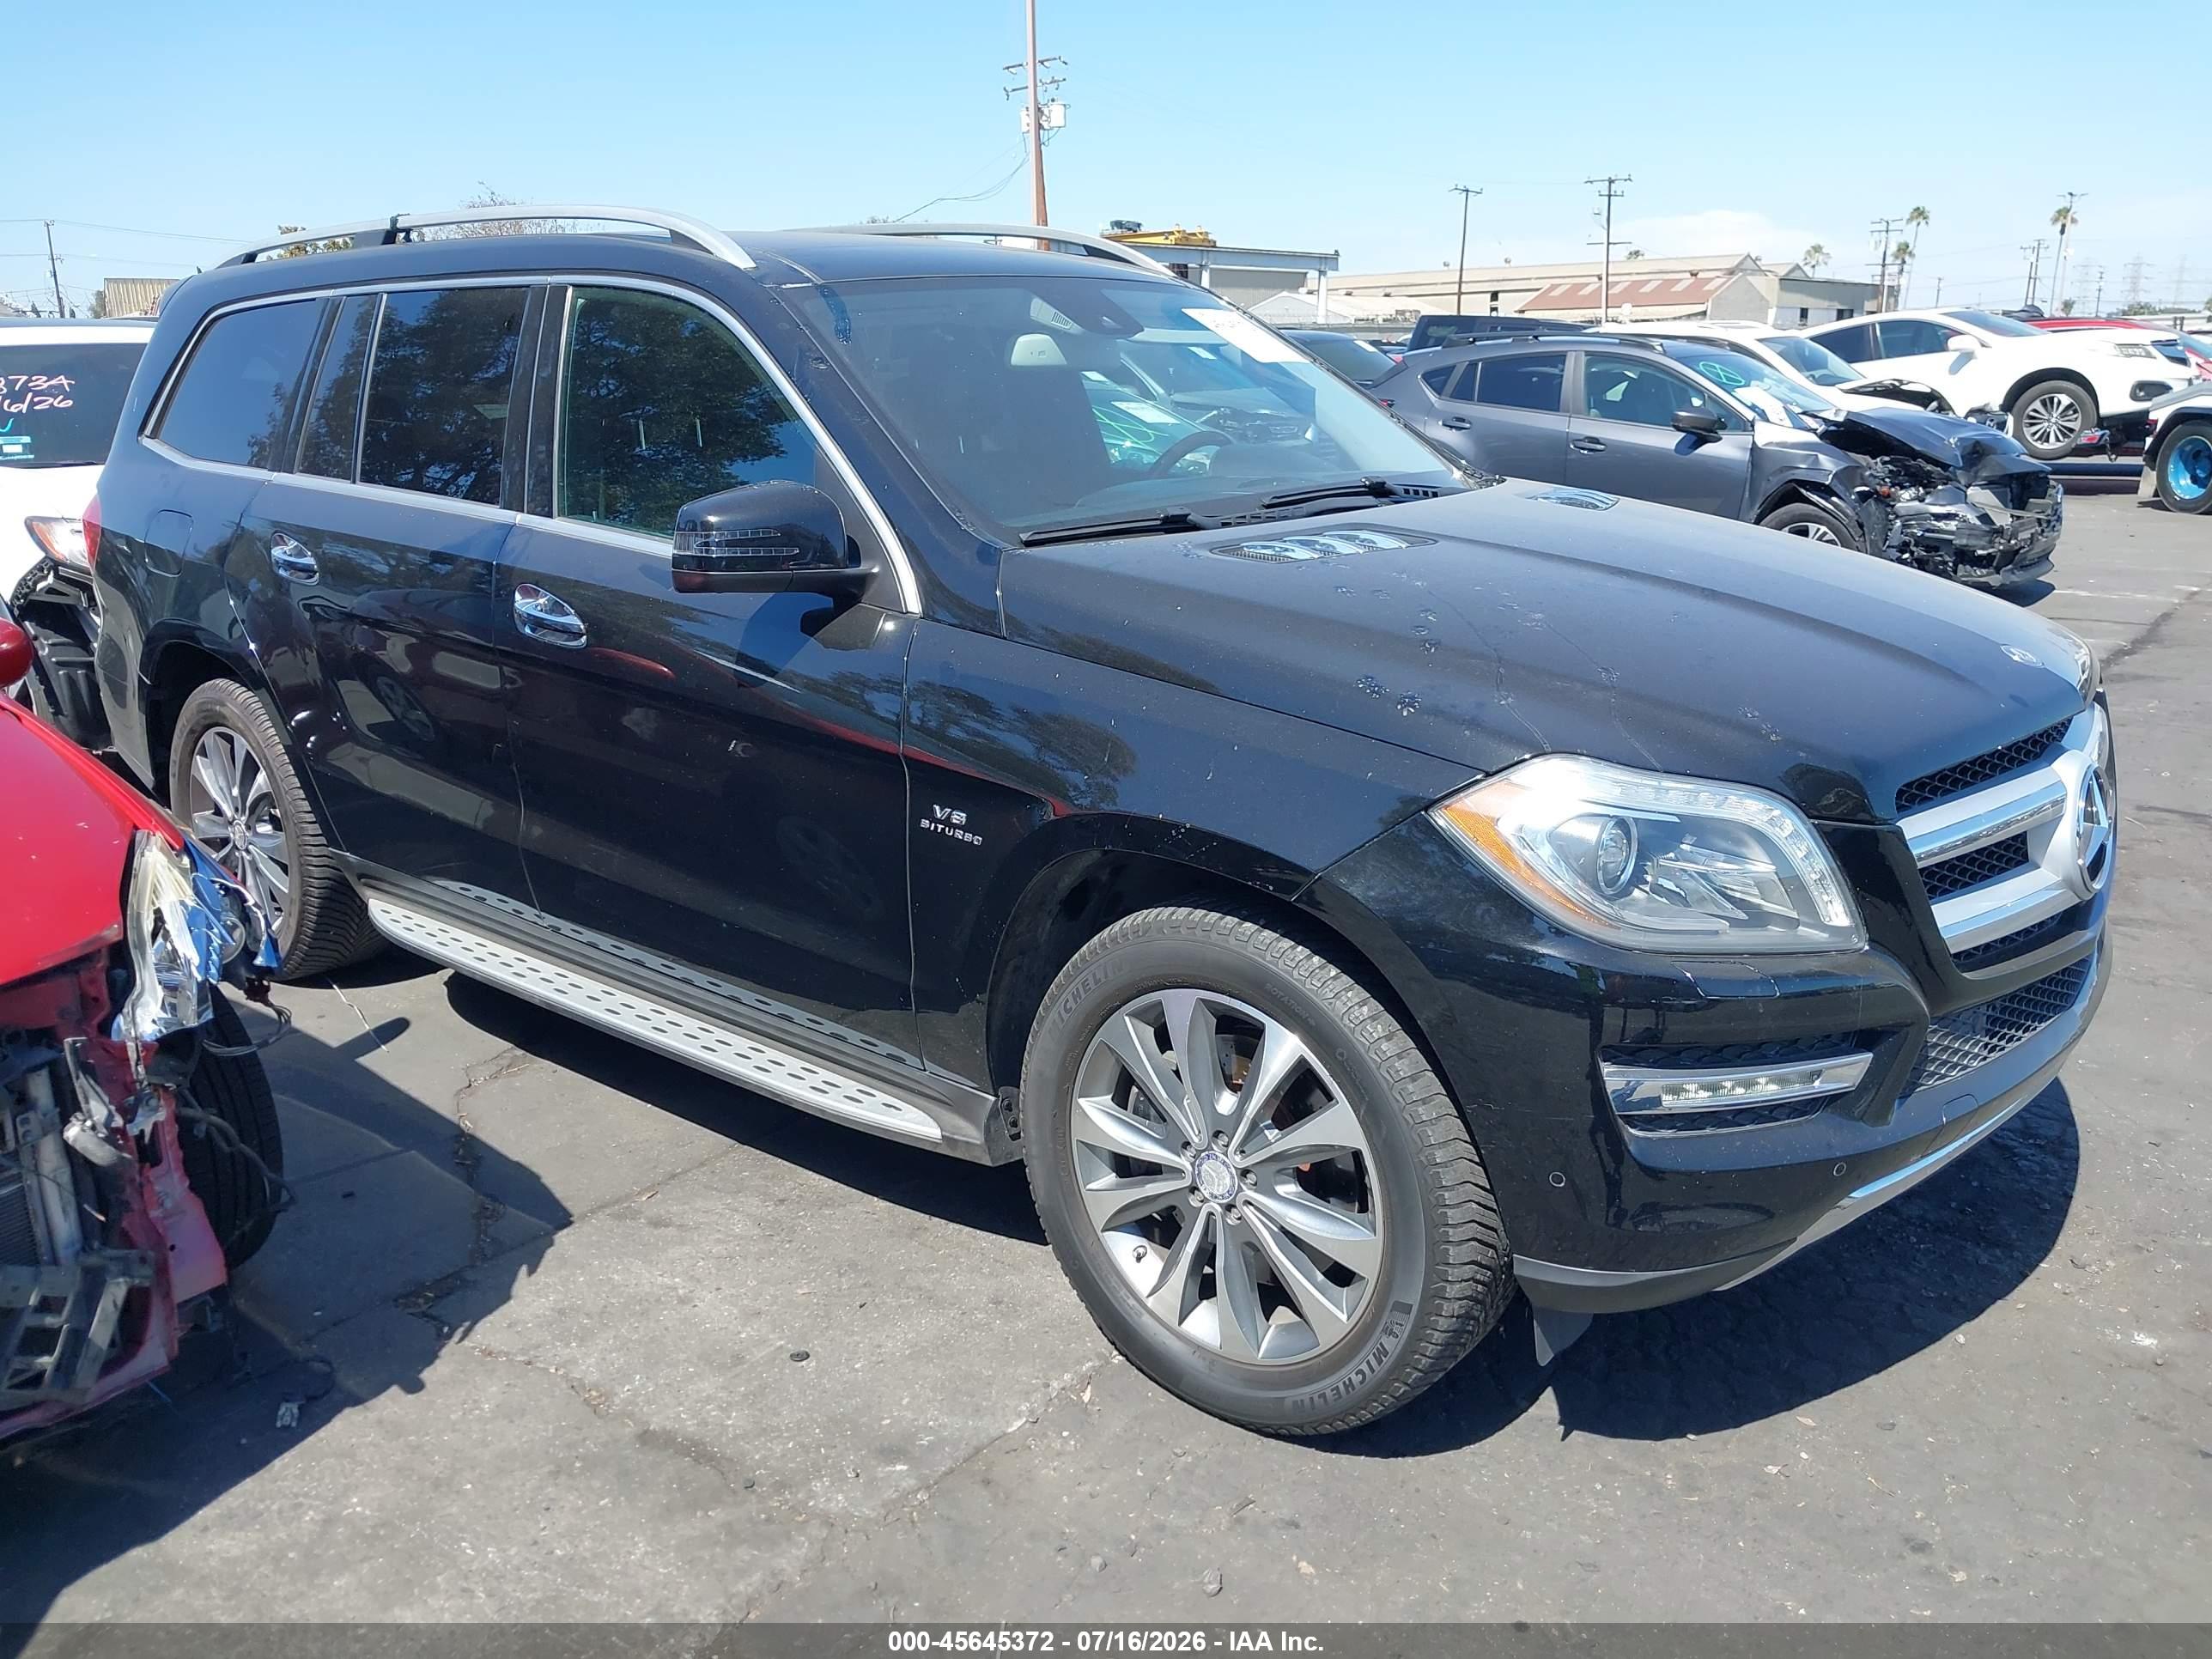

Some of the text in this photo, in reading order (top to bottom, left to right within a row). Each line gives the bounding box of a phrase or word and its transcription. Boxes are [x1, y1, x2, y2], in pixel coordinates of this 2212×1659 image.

[0, 392, 74, 414] 6/26
[933, 804, 967, 825] V8
[919, 818, 982, 846] BITURBO
[1291, 1340, 1389, 1413] MICHELIN
